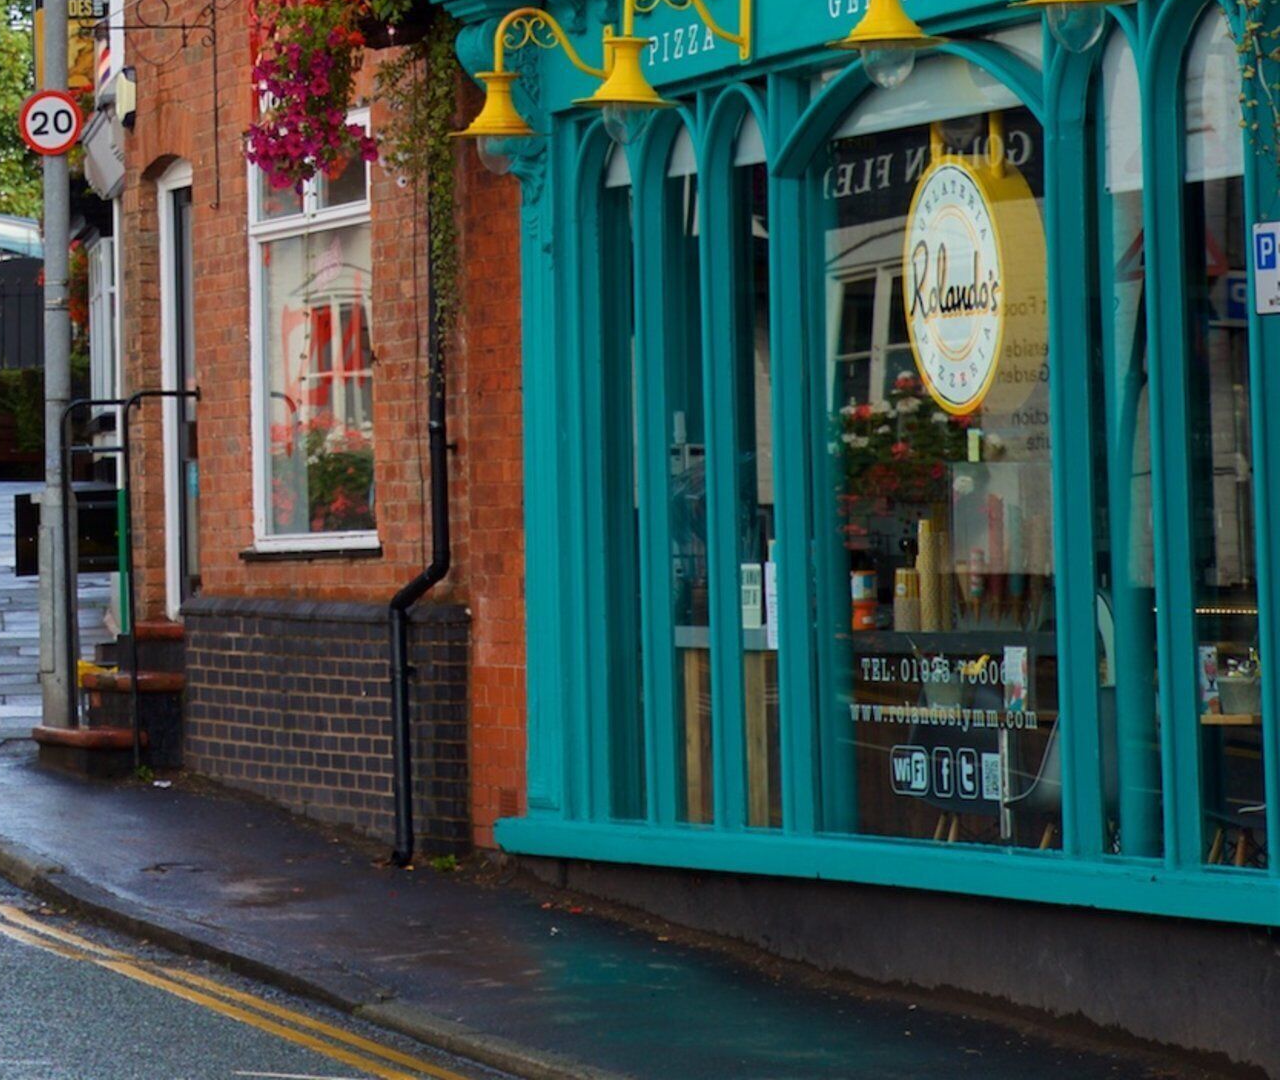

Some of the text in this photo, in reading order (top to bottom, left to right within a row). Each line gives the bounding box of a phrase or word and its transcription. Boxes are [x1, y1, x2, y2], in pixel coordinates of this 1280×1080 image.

[648, 23, 715, 66] PIZZA
[31, 109, 74, 136] 20
[1261, 237, 1273, 267] P
[910, 240, 999, 319] Rolando's
[861, 657, 896, 682] TEL:
[850, 701, 1039, 732] www.rolandoslymm.com
